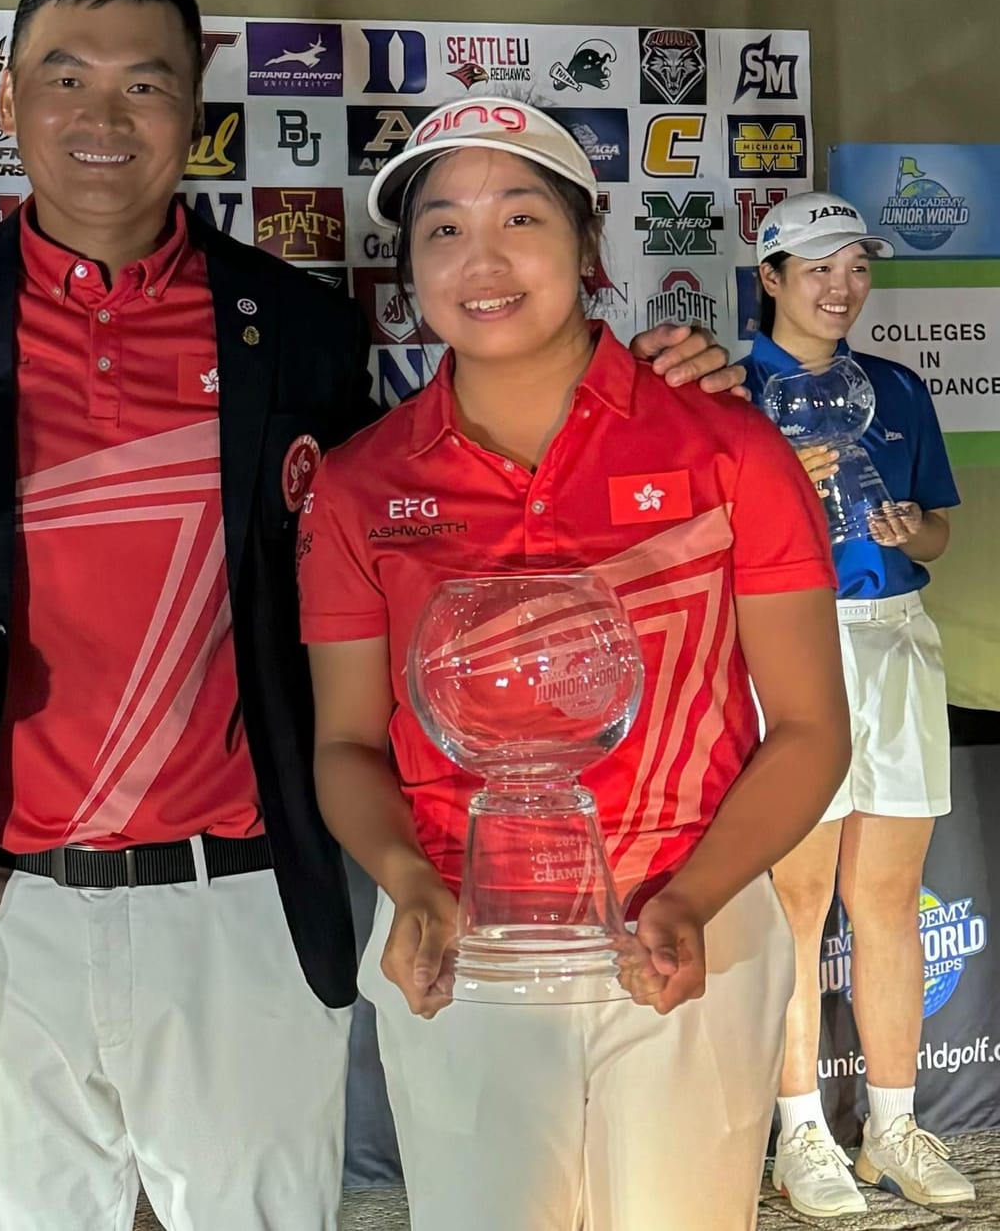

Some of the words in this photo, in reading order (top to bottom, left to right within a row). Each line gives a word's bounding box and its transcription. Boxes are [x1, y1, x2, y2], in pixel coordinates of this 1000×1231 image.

[249, 71, 291, 79] GRAND
[293, 72, 342, 80] CANYON
[490, 67, 531, 81] REDHAWKS
[416, 105, 527, 146] ping
[641, 113, 707, 179] C
[743, 143, 794, 152] MICHIGAN
[912, 195, 964, 207] ACADEMY
[646, 216, 675, 230] THE
[676, 216, 712, 230] HERD
[809, 205, 858, 223] JAPAN
[880, 208, 923, 225] JUNIOR
[925, 207, 969, 224] WORLD
[257, 211, 342, 244] STATE
[871, 324, 986, 342] COLLEGES
[919, 351, 941, 369] IN
[389, 498, 439, 519] EFG
[368, 520, 468, 540] ASHWORTH
